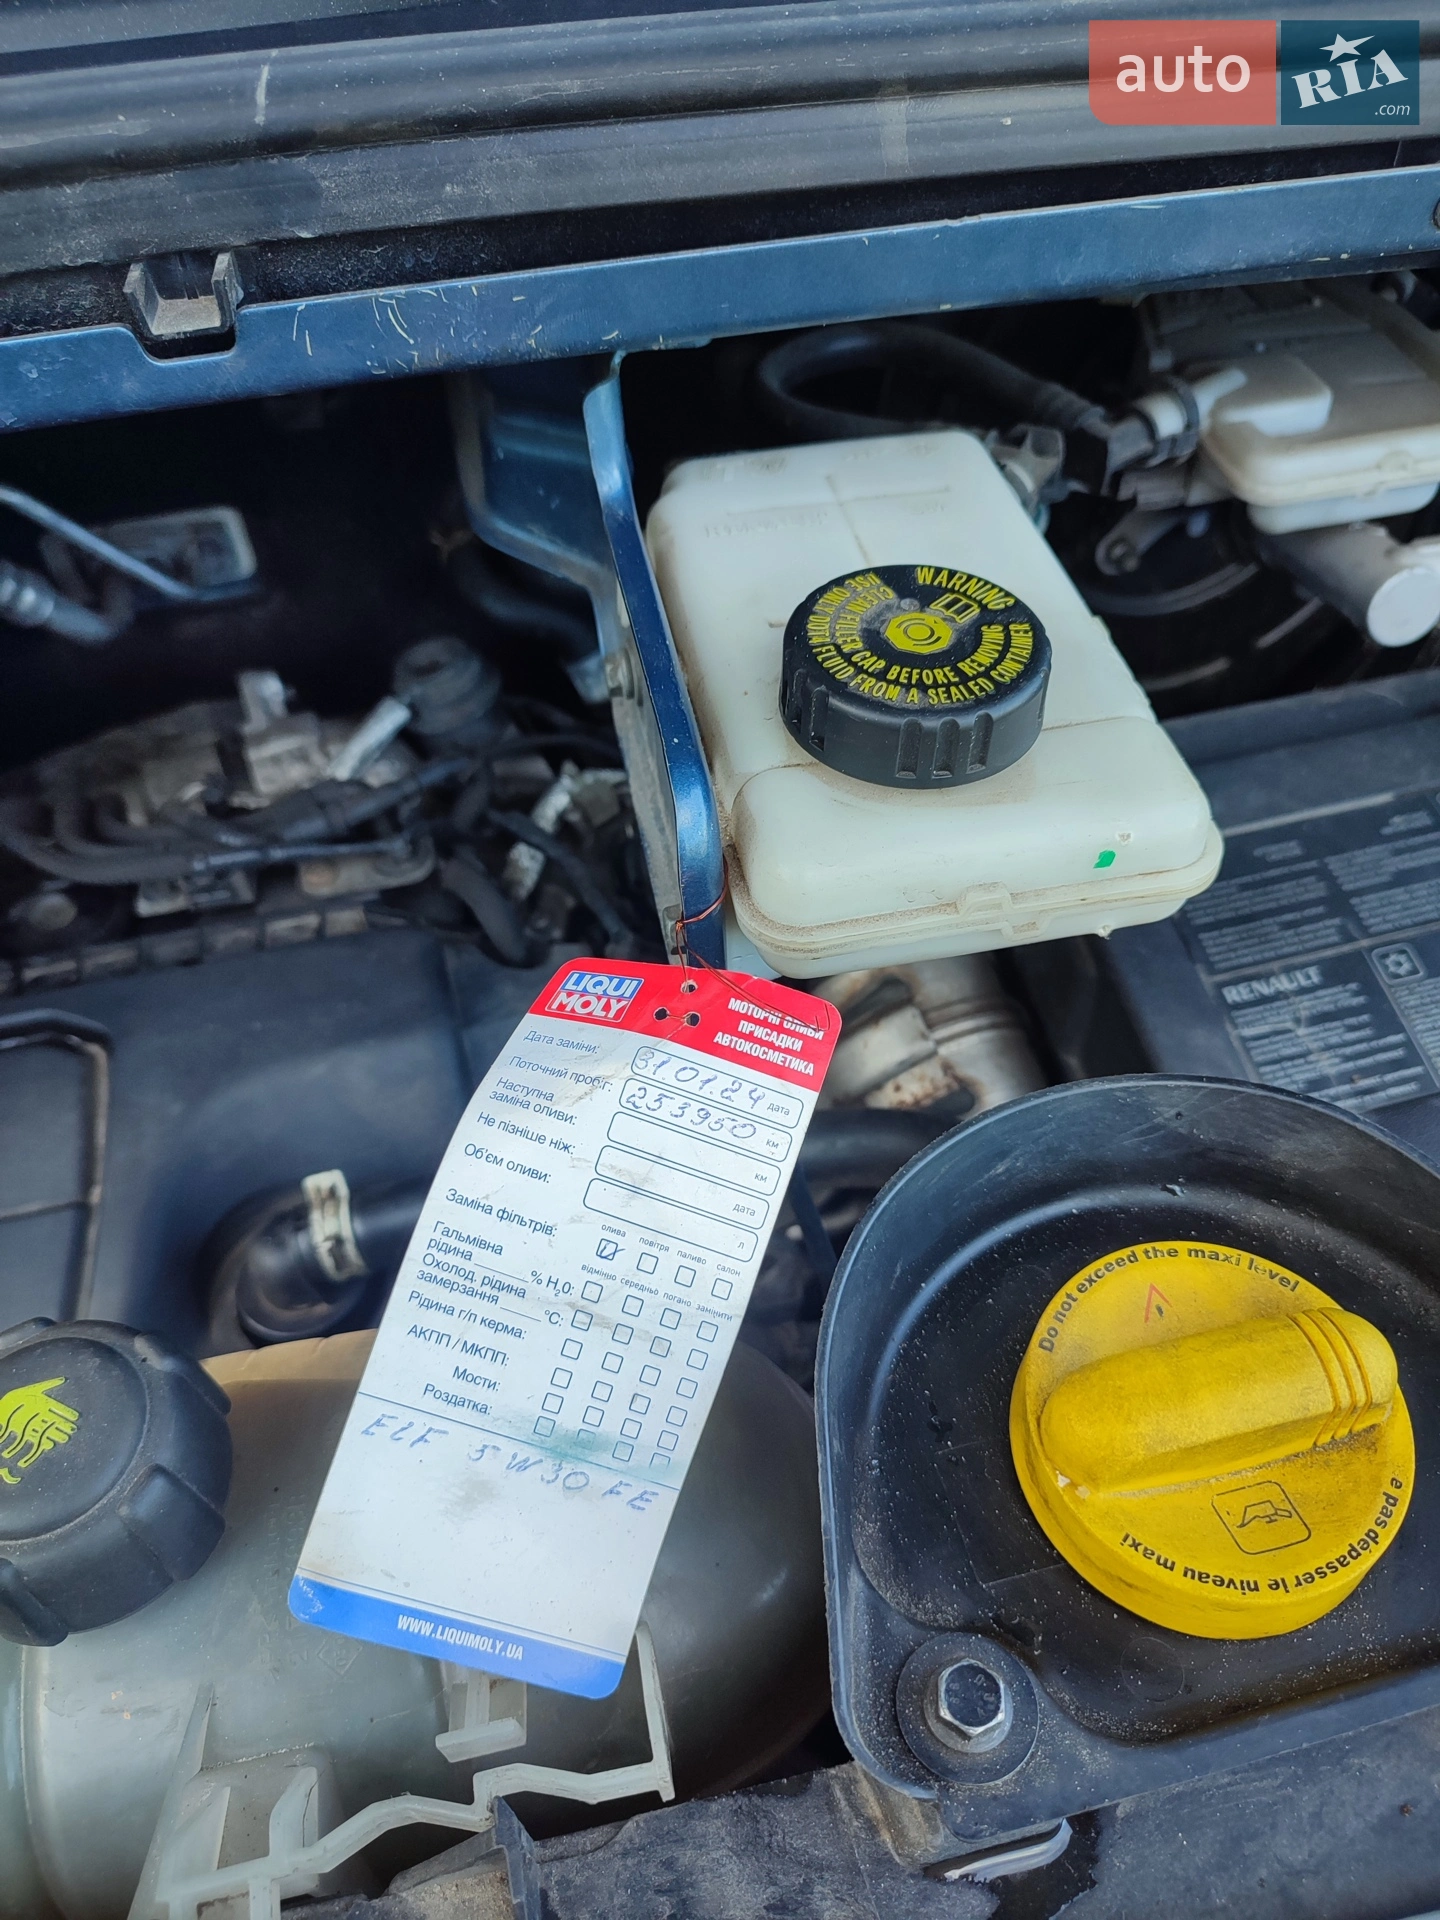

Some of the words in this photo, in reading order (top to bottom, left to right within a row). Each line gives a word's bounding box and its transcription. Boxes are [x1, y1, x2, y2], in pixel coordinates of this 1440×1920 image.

[844, 573, 881, 592] USE
[916, 566, 1016, 610] WARNING
[813, 587, 851, 615] ONLY
[845, 585, 894, 615] CLEAN
[835, 614, 863, 654] FILLER
[812, 645, 855, 680] FLUID
[851, 651, 886, 673] CAP
[957, 624, 1004, 677] REMOVING
[990, 623, 1033, 684] CONTAINER
[849, 674, 900, 703] FROM
[886, 665, 959, 685] BEFORE
[927, 677, 995, 705] SEALED
[906, 687, 919, 704] A
[564, 971, 641, 998] LIQUI
[1221, 964, 1323, 1005] RENAULT
[549, 993, 629, 1021] MOLY
[727, 998, 782, 1024] МОТОРНІ
[523, 1030, 554, 1045] Дата
[556, 1037, 600, 1054] заміни:
[738, 1020, 804, 1052] ПРИСАДКИ
[713, 1032, 815, 1076] АВТОКОСМЕТИКА
[496, 1077, 555, 1102] Наступна
[508, 1056, 569, 1079] Поточний
[569, 1072, 614, 1092] пробіг:
[489, 1090, 531, 1110] заміна
[533, 1103, 578, 1126] оливи:
[767, 1102, 791, 1116] дата
[477, 1111, 497, 1127] Не
[497, 1120, 547, 1145] пізніше
[548, 1138, 576, 1155] ніж:
[765, 1139, 780, 1149] км
[506, 1159, 552, 1184] оливи:
[754, 1172, 769, 1184] км
[445, 1188, 492, 1215] Заміна
[496, 1206, 558, 1237] фільтрів:
[732, 1202, 757, 1217] дата
[427, 1237, 473, 1262] рідина
[433, 1220, 504, 1256] Гальмівна
[601, 1224, 627, 1238] олива
[639, 1235, 670, 1253] повітря
[677, 1249, 707, 1266] паливо
[716, 1262, 741, 1277] салон
[737, 1241, 745, 1249] л
[416, 1269, 500, 1306] замерзання
[422, 1252, 478, 1283] Охолод.
[480, 1274, 527, 1299] рідина
[581, 1262, 617, 1281] відмінно
[620, 1275, 659, 1296] середньо
[663, 1291, 692, 1308] погано
[696, 1302, 733, 1322] замінити
[1037, 1325, 1059, 1353] Do
[1052, 1290, 1079, 1324] not
[1075, 1249, 1139, 1294] exceed
[1142, 1246, 1179, 1260] the
[1187, 1247, 1242, 1267] maxi
[1246, 1257, 1300, 1293] level
[408, 1290, 454, 1317] Рідина
[457, 1308, 477, 1323] г/п
[480, 1316, 528, 1340] керма:
[407, 1324, 452, 1348] АКПП
[460, 1339, 511, 1367] МКПП:
[452, 1365, 501, 1392] Мости:
[423, 1383, 493, 1416] Роздатка:
[1374, 1490, 1400, 1530] pas
[1119, 1531, 1176, 1573] maxi
[1294, 1527, 1380, 1589] dépasser
[1182, 1565, 1261, 1596] niveau
[1267, 1577, 1290, 1594] le
[396, 1613, 525, 1661] WWW.LIQUIMOLY.UA
